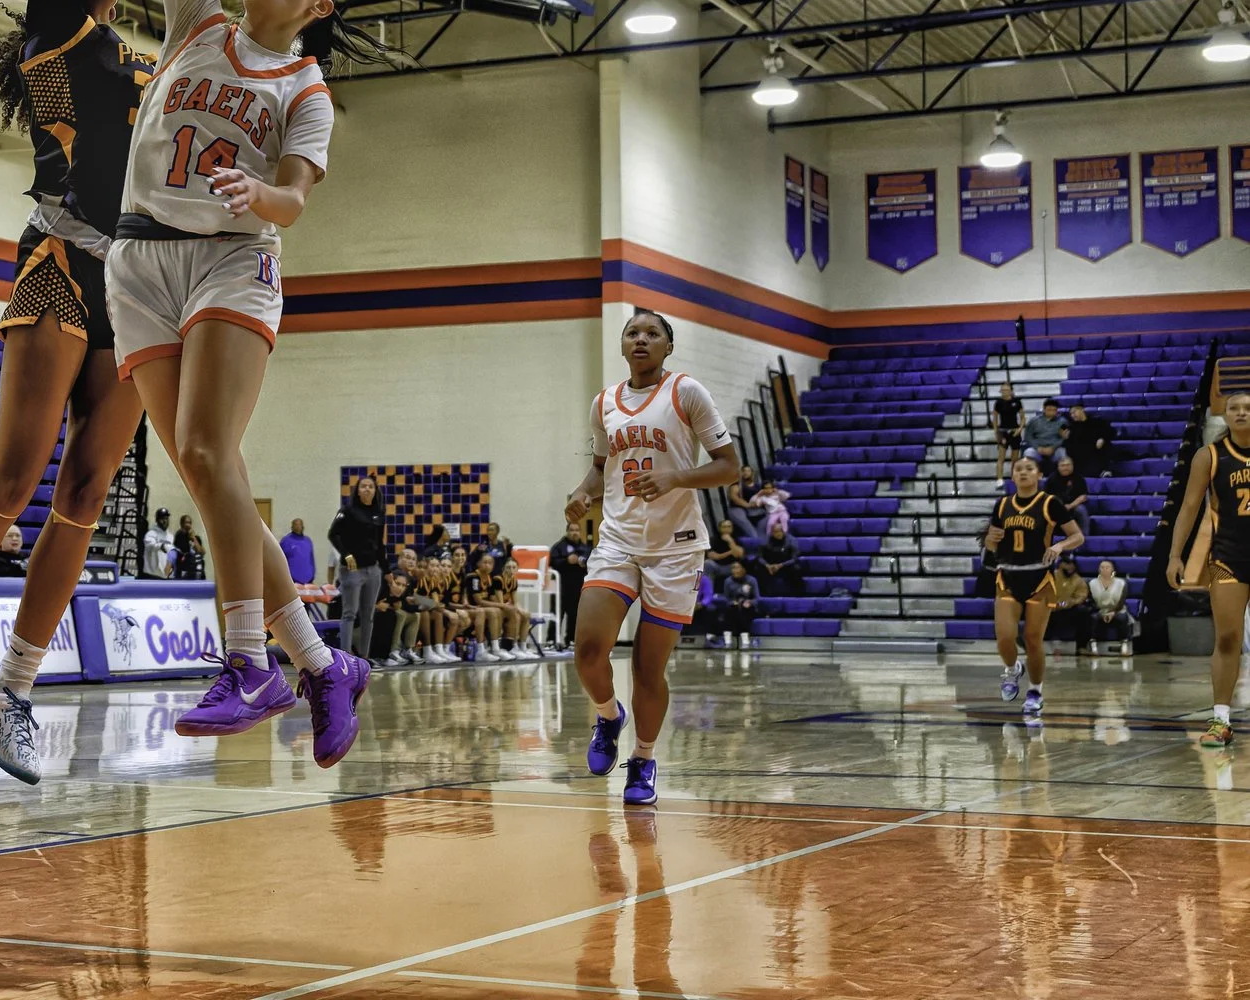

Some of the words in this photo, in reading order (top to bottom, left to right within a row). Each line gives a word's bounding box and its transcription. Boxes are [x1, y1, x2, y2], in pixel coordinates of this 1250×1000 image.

[163, 77, 274, 150] GAELS
[165, 124, 240, 197] 14
[1004, 515, 1036, 530] PARKER
